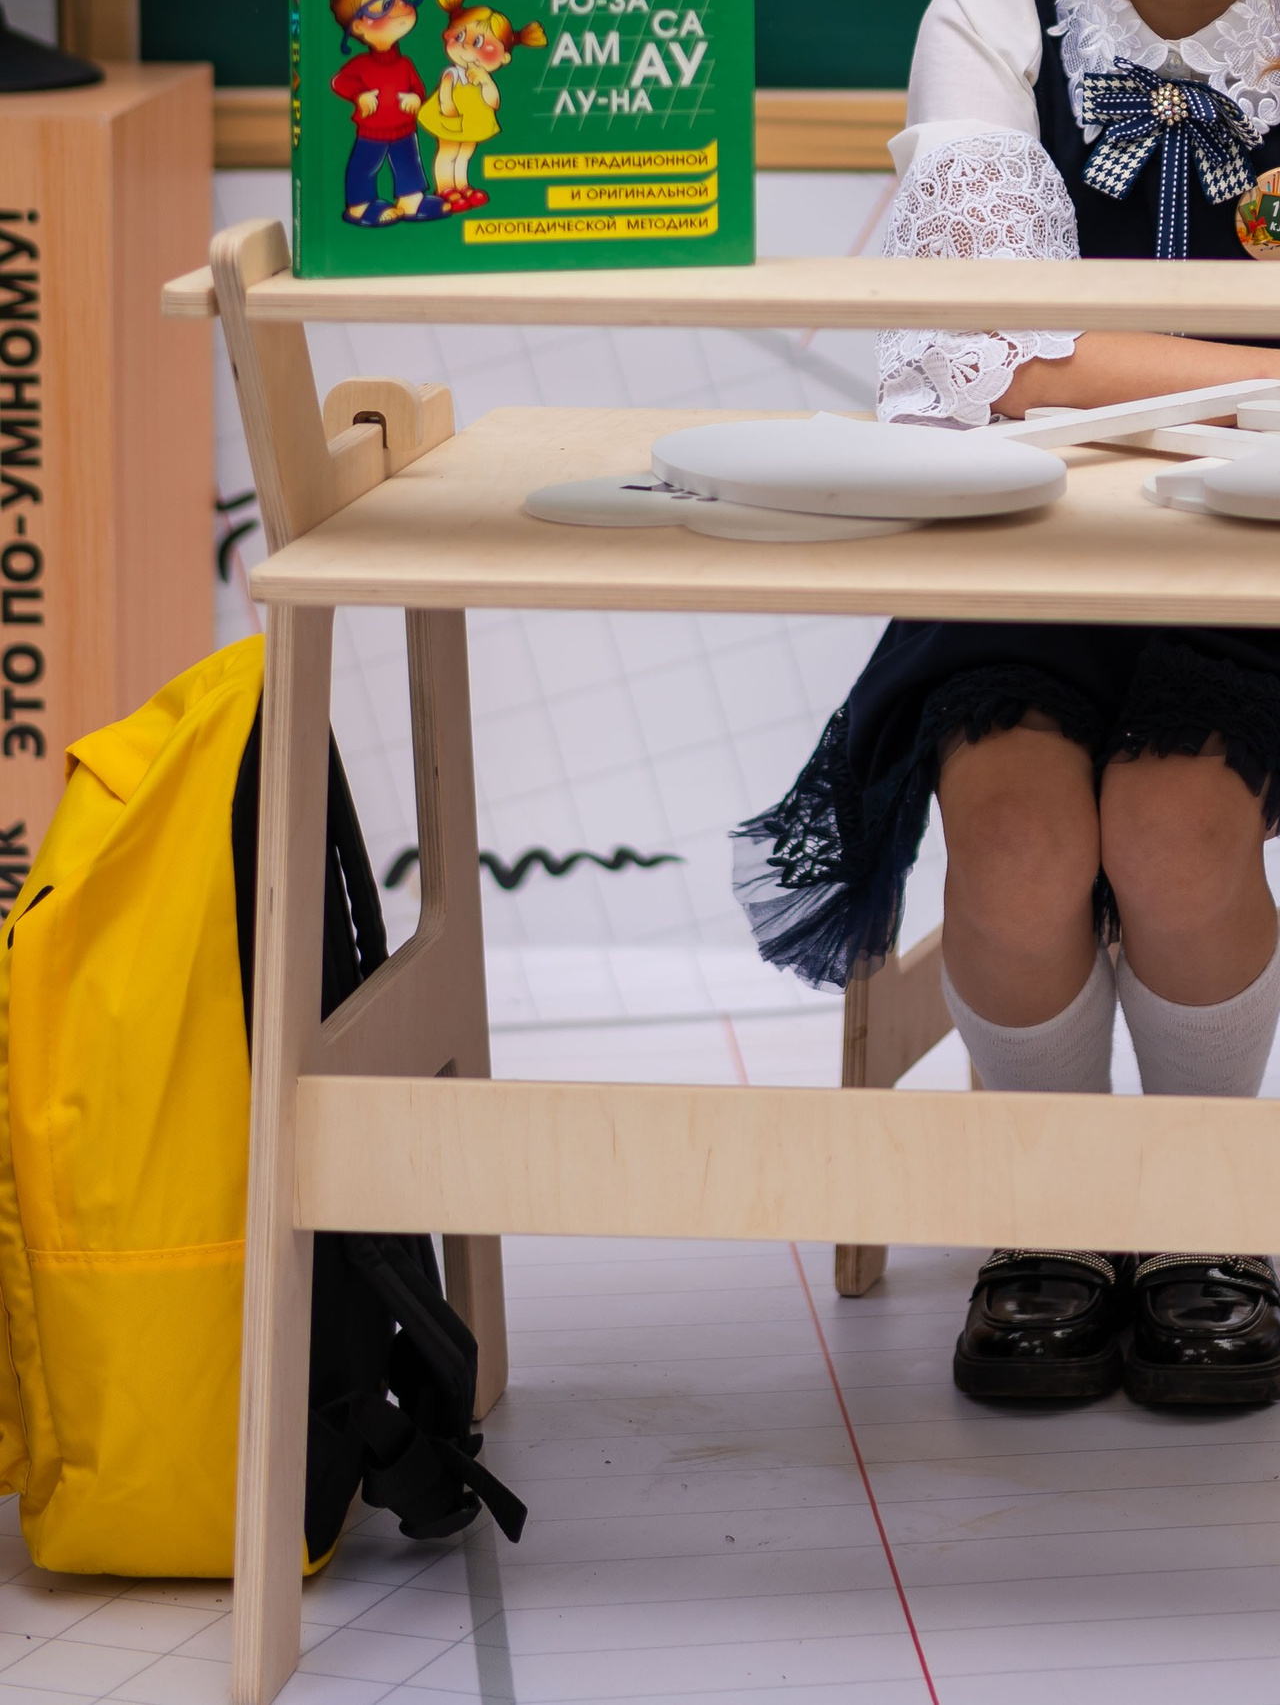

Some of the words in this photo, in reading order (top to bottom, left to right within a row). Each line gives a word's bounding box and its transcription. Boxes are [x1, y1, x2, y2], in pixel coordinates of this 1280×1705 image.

[651, 9, 705, 38] СА
[551, 30, 621, 67] АМ
[630, 41, 709, 88] АУ
[553, 89, 654, 115] ЛУ-НА
[493, 156, 580, 171] СОЧЕТАНИЕ
[584, 150, 709, 170] ТРАДИЦИОННОЙ
[570, 188, 582, 201] И
[586, 181, 709, 200] ОРИГИНАЛЬНОЙ
[475, 214, 618, 235] ЛОГОПЕДИЧЕСКОЙ
[626, 217, 709, 231] МЕТОДИКИ
[0, 208, 44, 628] ПО-УМНОМУ!
[2, 642, 47, 760] ЭТО
